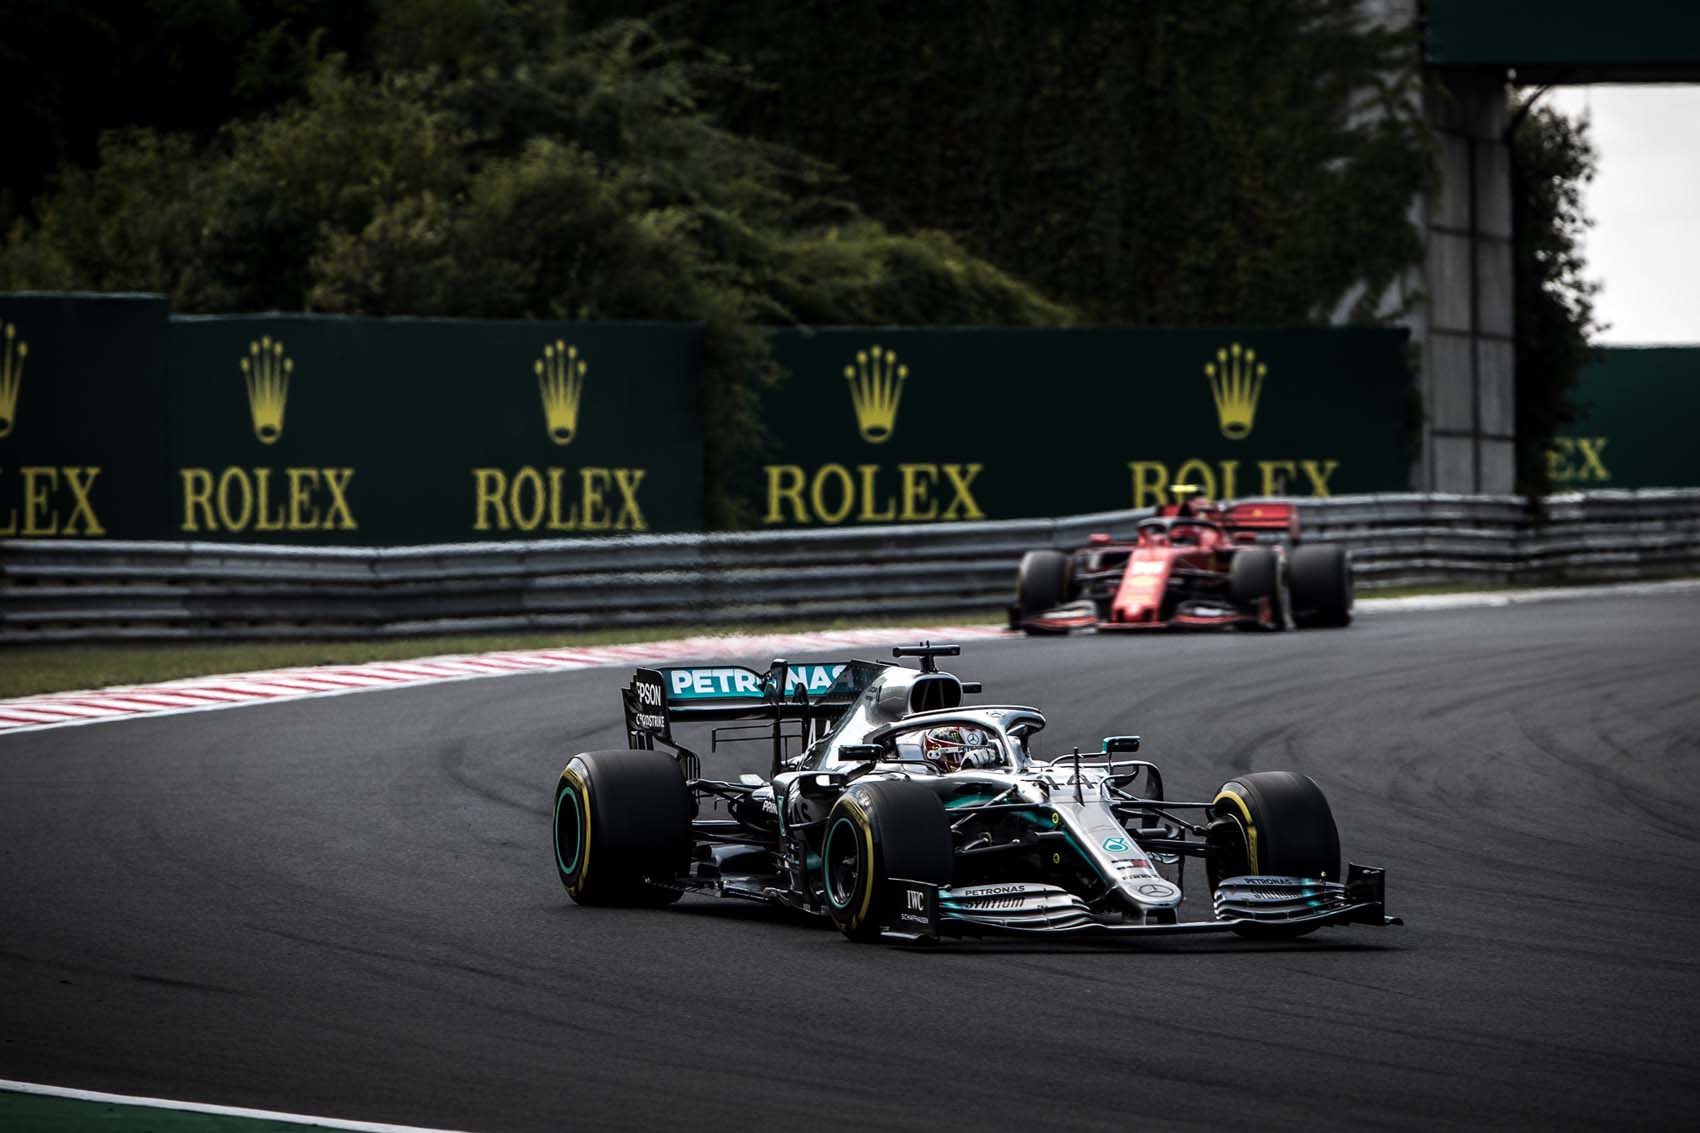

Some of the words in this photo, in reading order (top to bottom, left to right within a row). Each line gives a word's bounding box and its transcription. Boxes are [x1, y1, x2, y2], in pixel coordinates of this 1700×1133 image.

[180, 467, 358, 532] ROLEX
[473, 467, 648, 531] ROLEX
[764, 463, 984, 524] ROLEX
[906, 889, 924, 911] IWC
[965, 885, 1025, 896] PETRONAS
